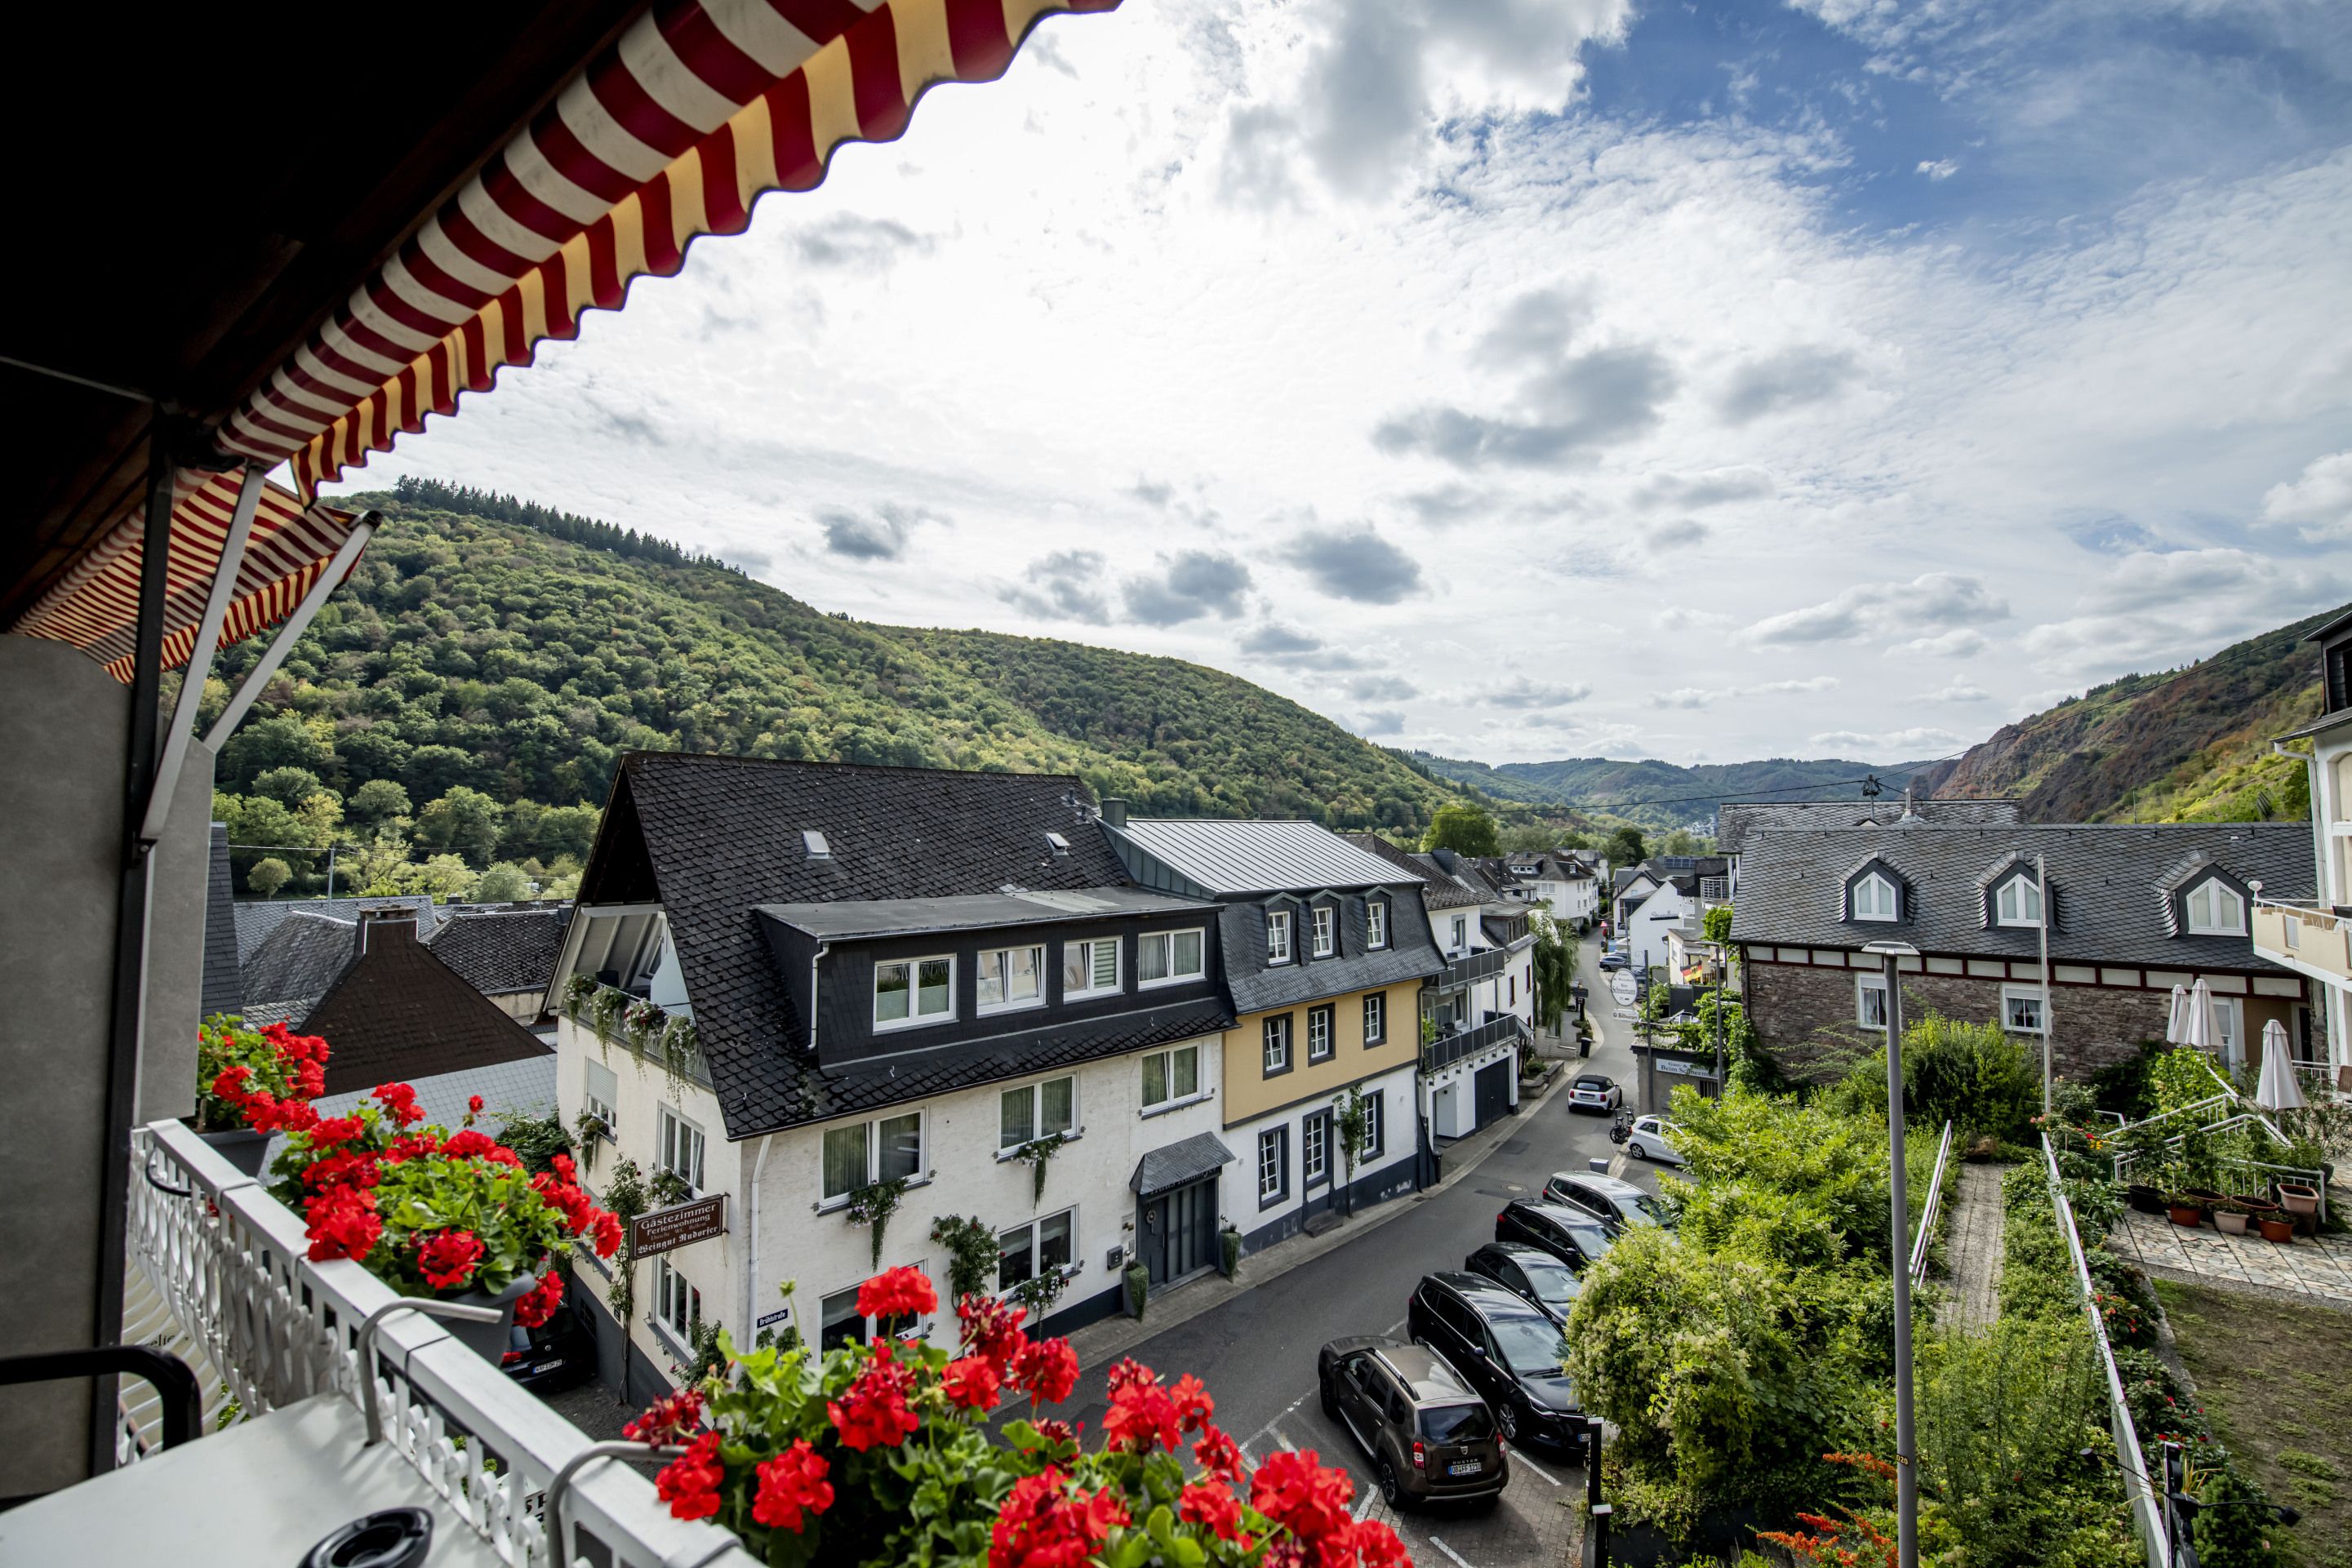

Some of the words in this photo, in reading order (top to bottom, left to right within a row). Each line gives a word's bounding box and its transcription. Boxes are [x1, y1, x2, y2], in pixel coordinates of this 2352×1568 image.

[641, 1203, 716, 1229] Gästezimmer
[647, 1215, 710, 1236] Ferienwohnung
[637, 1237, 676, 1254] Weingut
[679, 1226, 718, 1242] Rudorfer
[651, 1232, 670, 1241] Dusche
[689, 1222, 706, 1230] Balkon
[759, 1312, 785, 1326] Brühlstraße
